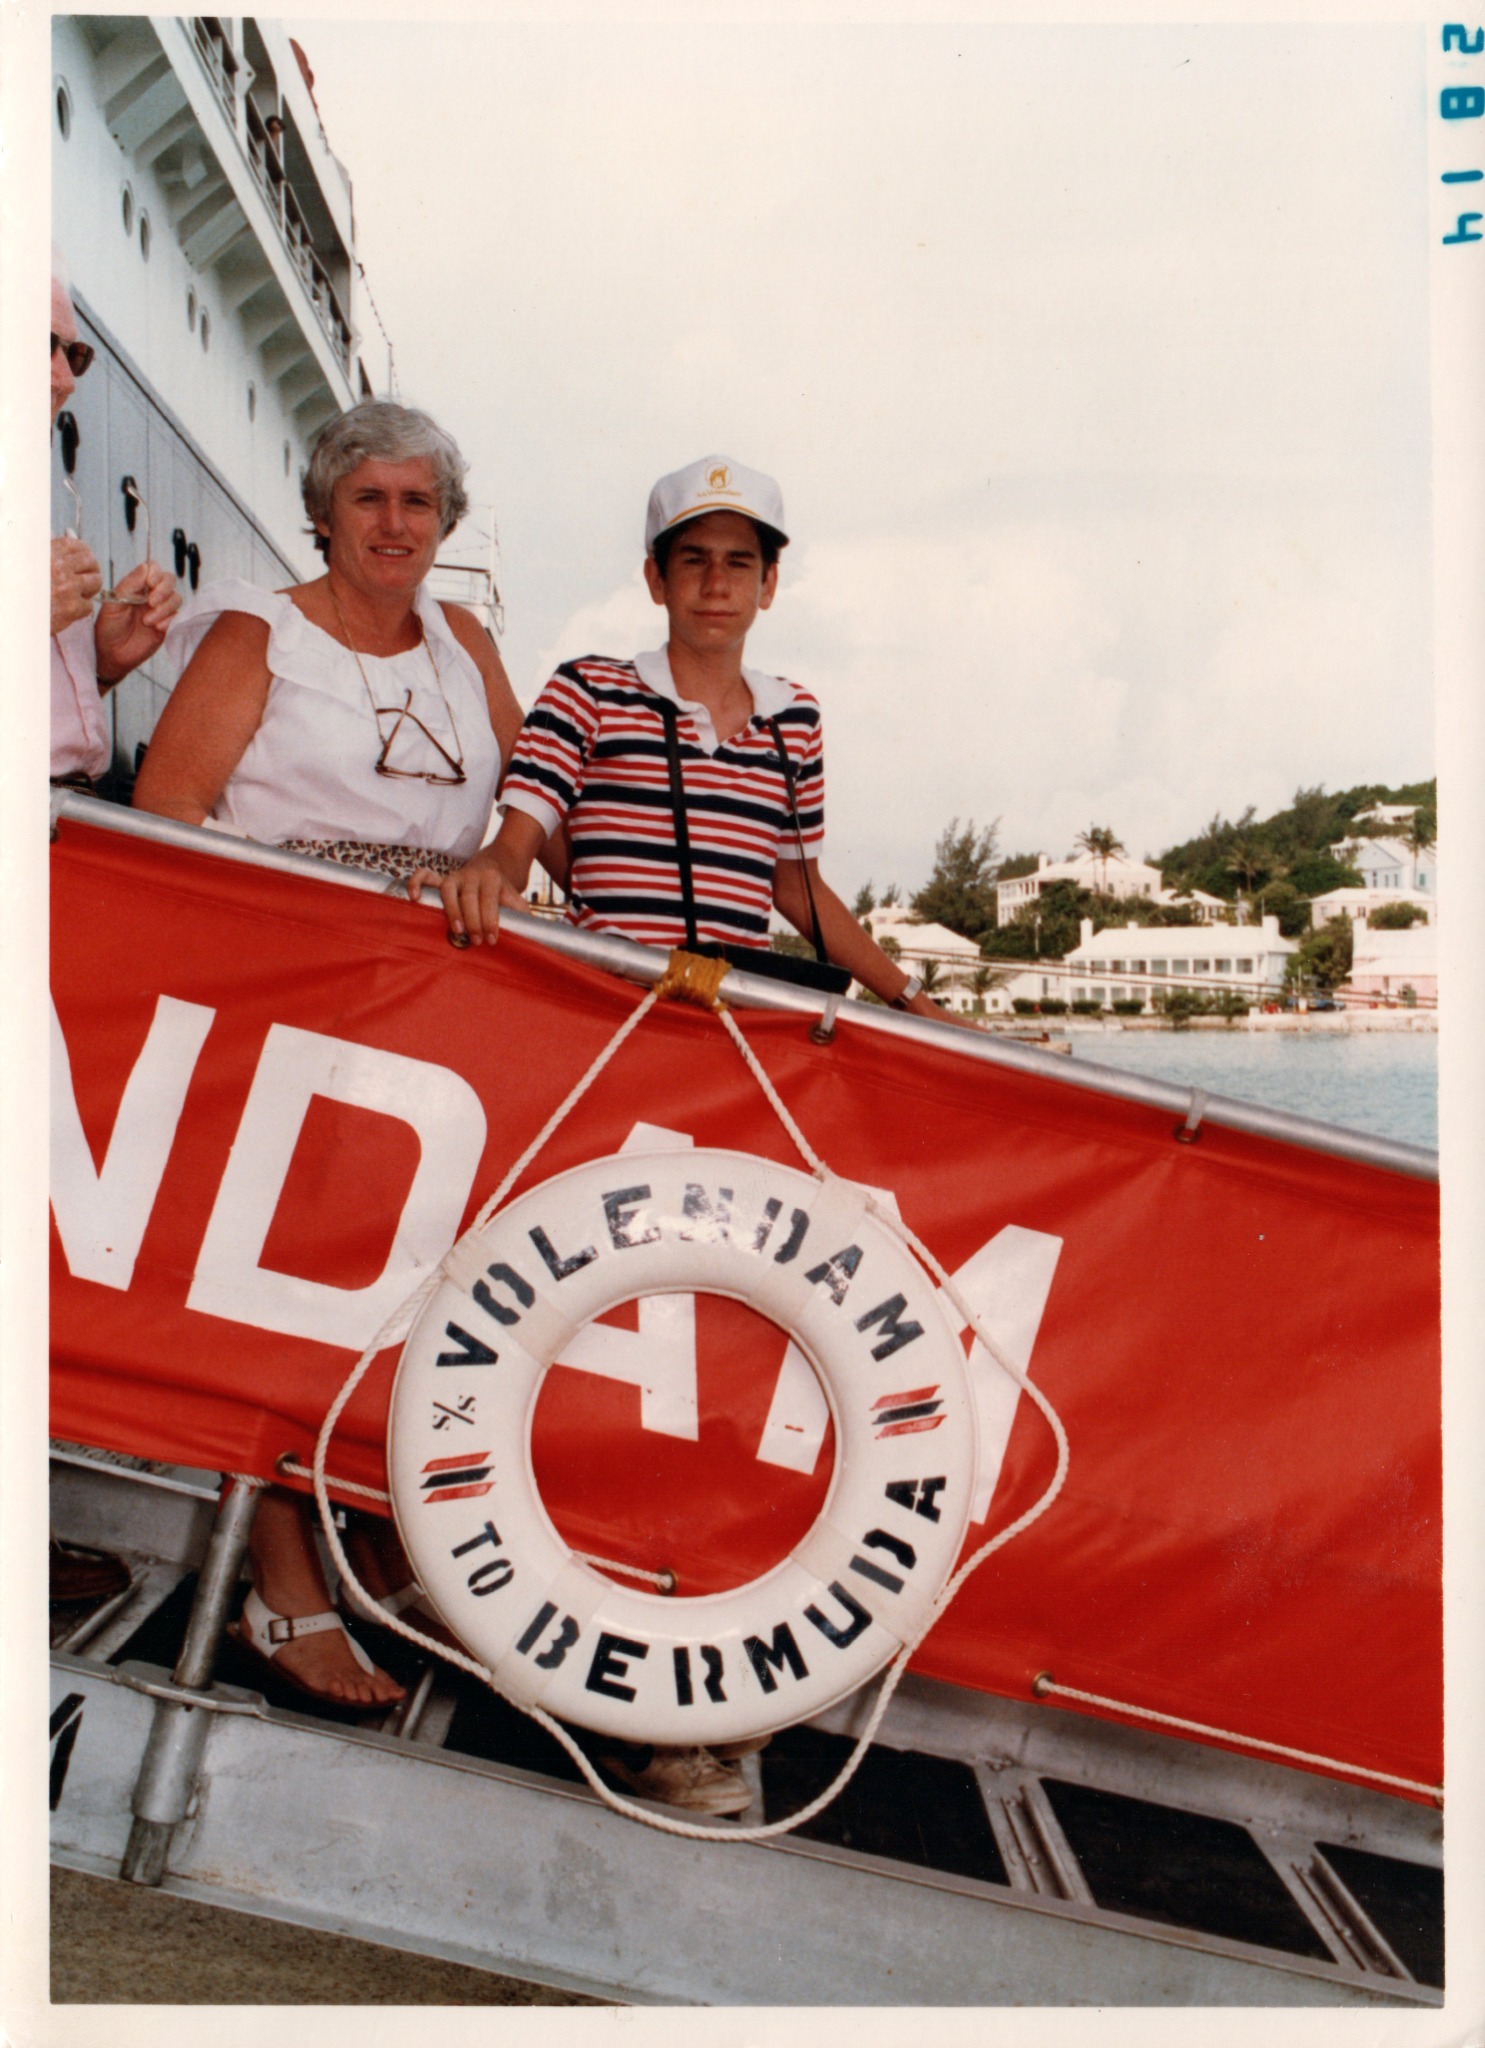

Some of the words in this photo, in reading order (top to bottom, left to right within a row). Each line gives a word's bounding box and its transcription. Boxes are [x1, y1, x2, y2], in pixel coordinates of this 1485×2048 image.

[435, 1183, 925, 1367] VOLENDAM
[452, 1520, 515, 1597] TO
[515, 1475, 948, 1706] BERMUDA
